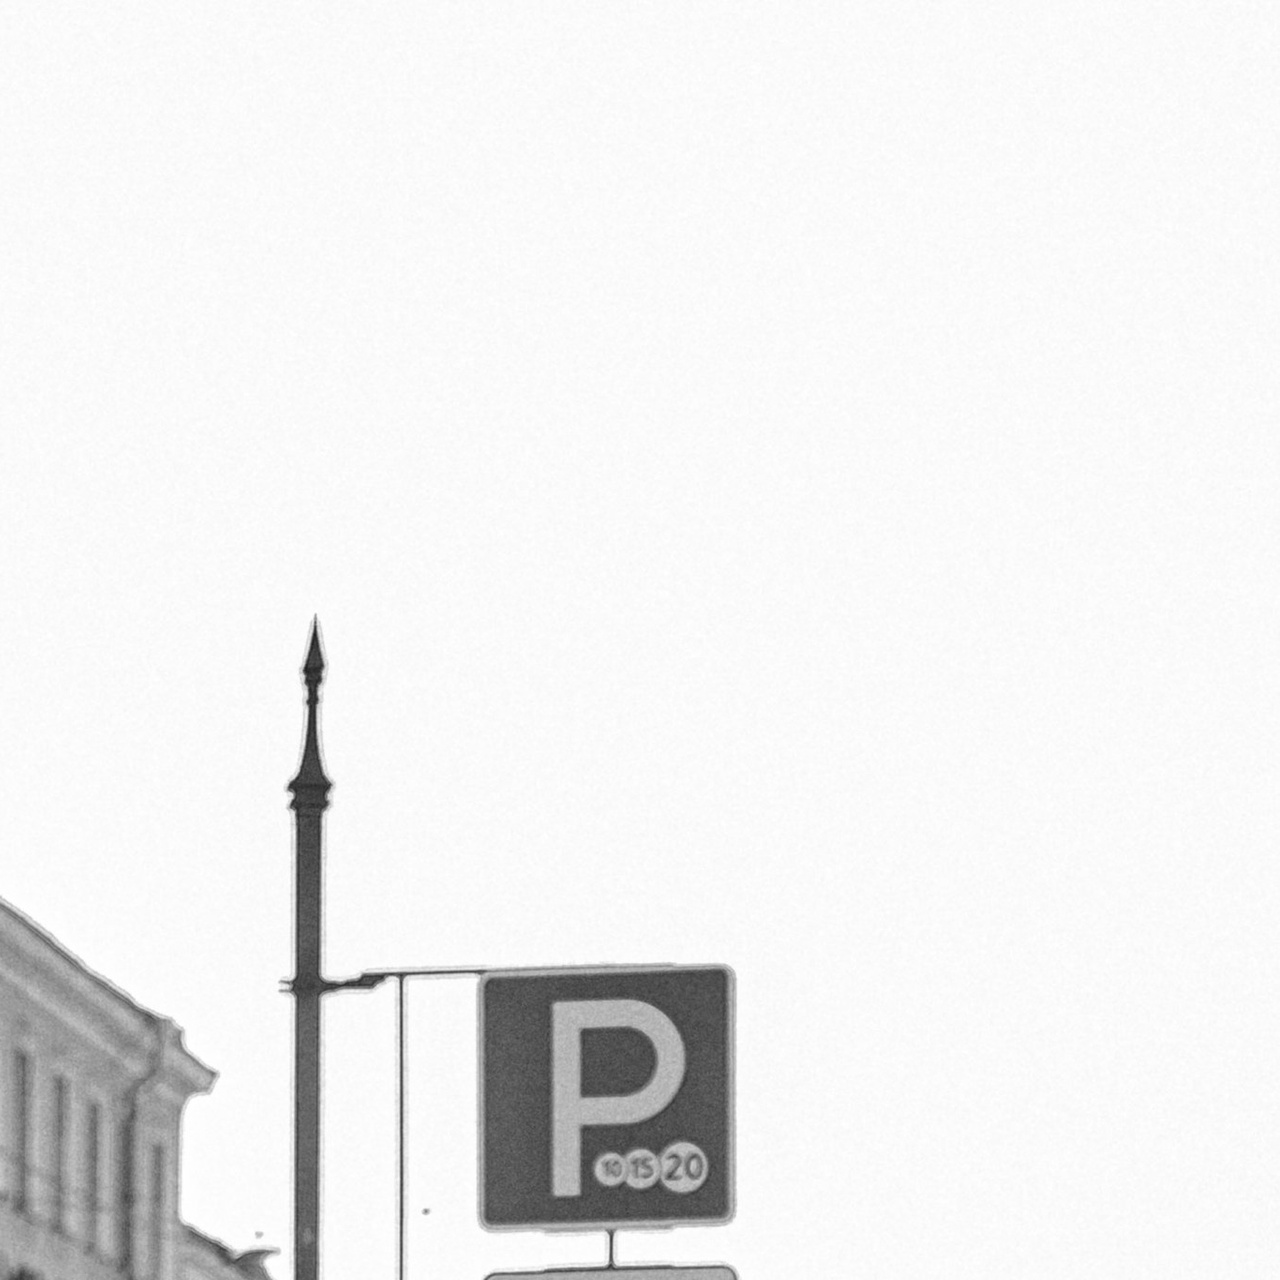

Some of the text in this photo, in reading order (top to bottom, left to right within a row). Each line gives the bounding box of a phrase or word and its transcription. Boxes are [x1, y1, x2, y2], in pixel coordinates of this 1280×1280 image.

[551, 999, 686, 1198] P
[629, 1156, 655, 1180] 15
[664, 1152, 703, 1182] 20
